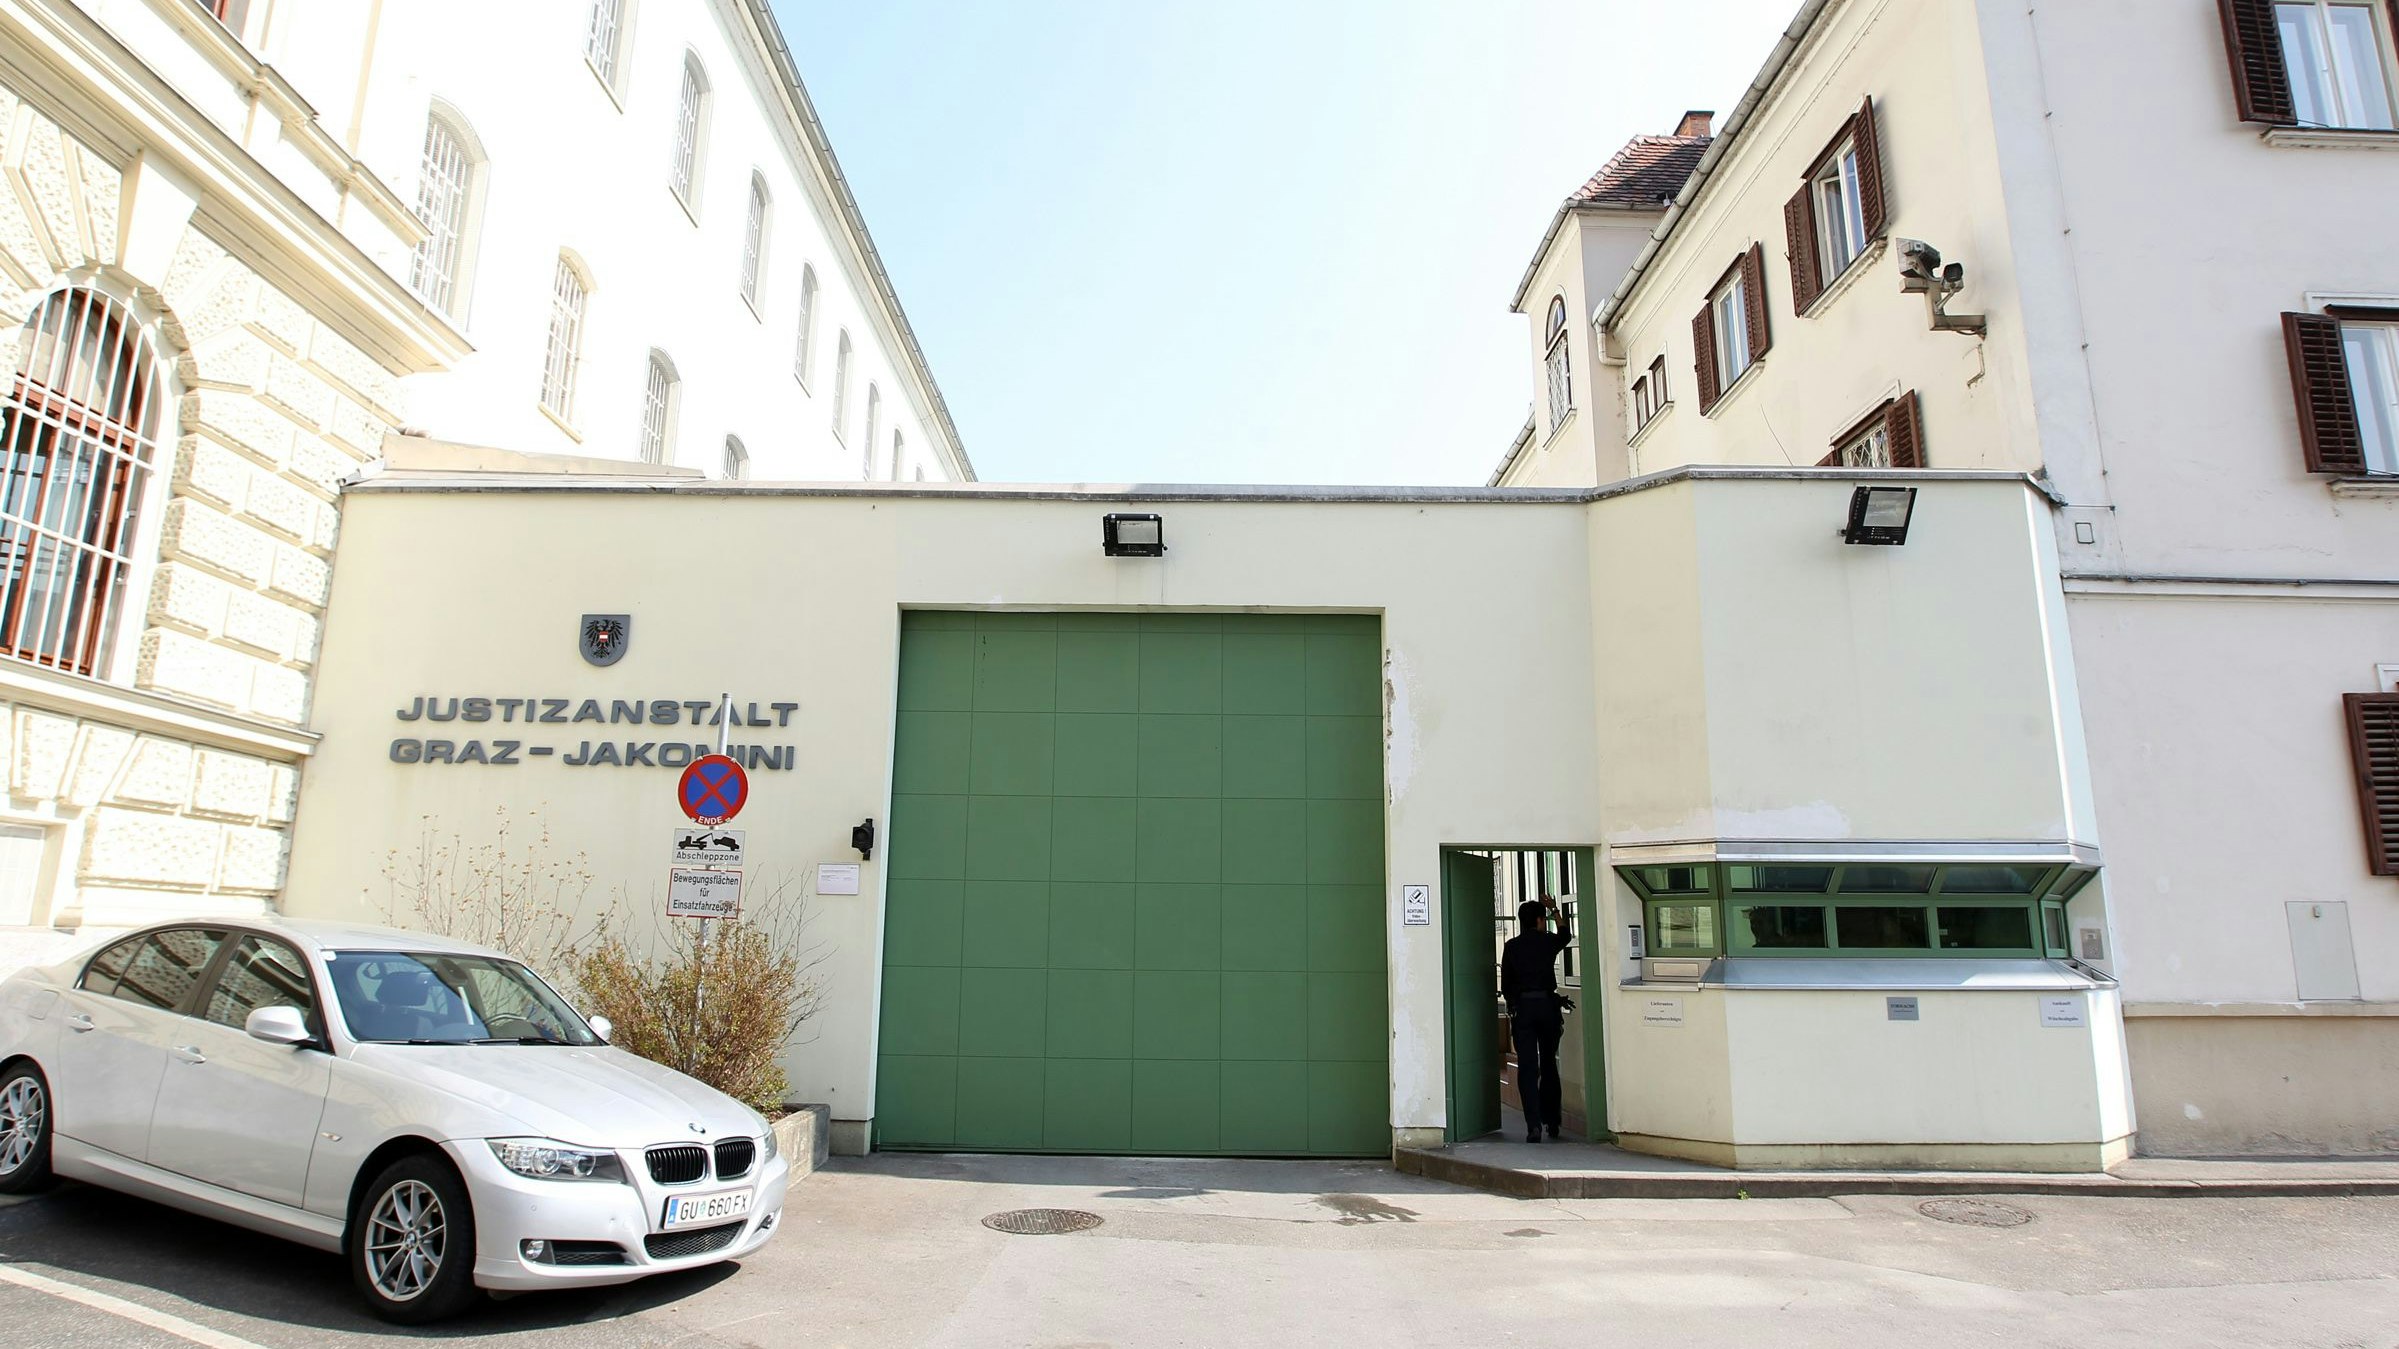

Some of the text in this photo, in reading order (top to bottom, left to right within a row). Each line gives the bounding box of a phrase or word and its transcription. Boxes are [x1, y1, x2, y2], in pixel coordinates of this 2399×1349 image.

[396, 697, 798, 726] JUSTIZANSTALT
[697, 815, 724, 825] ENDE
[676, 851, 740, 862] Abschleppzone
[673, 872, 739, 886] Bewegungsflächen
[699, 887, 710, 897] für
[680, 1201, 698, 1220] GU
[707, 1196, 732, 1217] 660
[733, 1194, 749, 1213] FX
